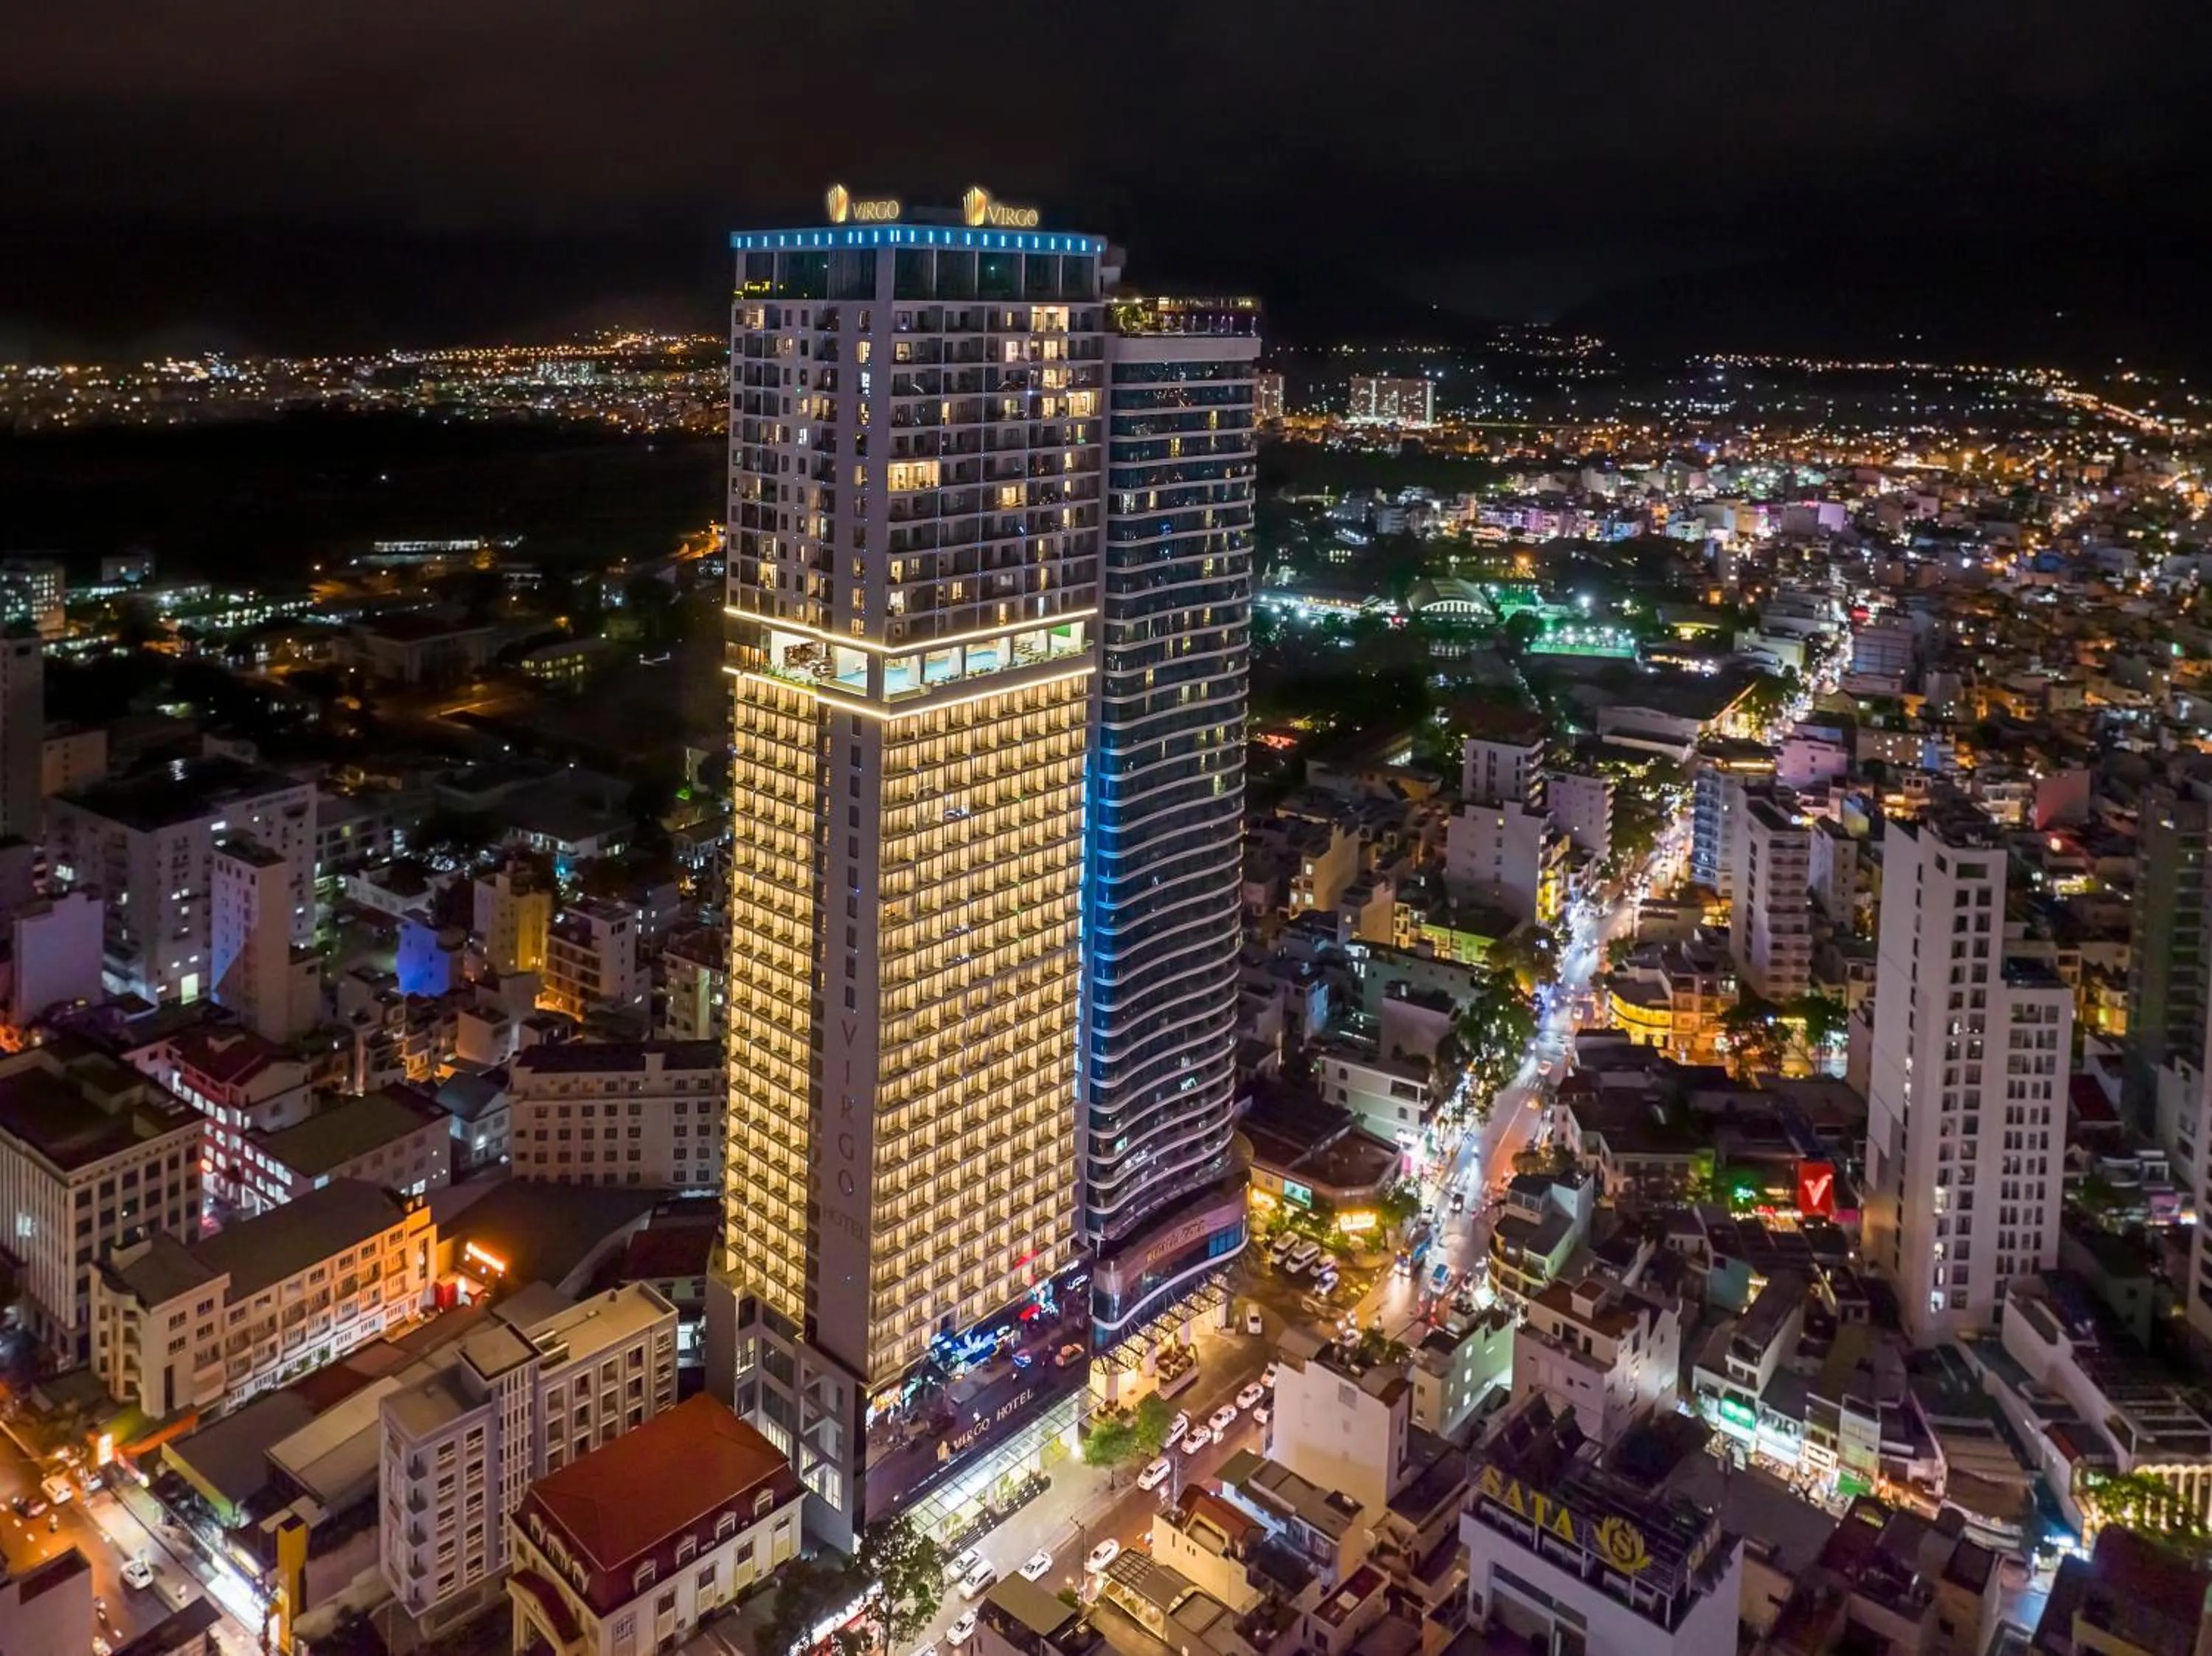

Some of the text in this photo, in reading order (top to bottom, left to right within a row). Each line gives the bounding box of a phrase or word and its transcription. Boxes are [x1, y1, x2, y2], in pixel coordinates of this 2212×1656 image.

[852, 200, 900, 220] VIRGO
[987, 205, 1040, 226] VIRGO
[838, 1019, 857, 1197] VIRGO
[952, 1388, 1034, 1450] VIRGO HOTEL
[1479, 1464, 1576, 1543] SATA
